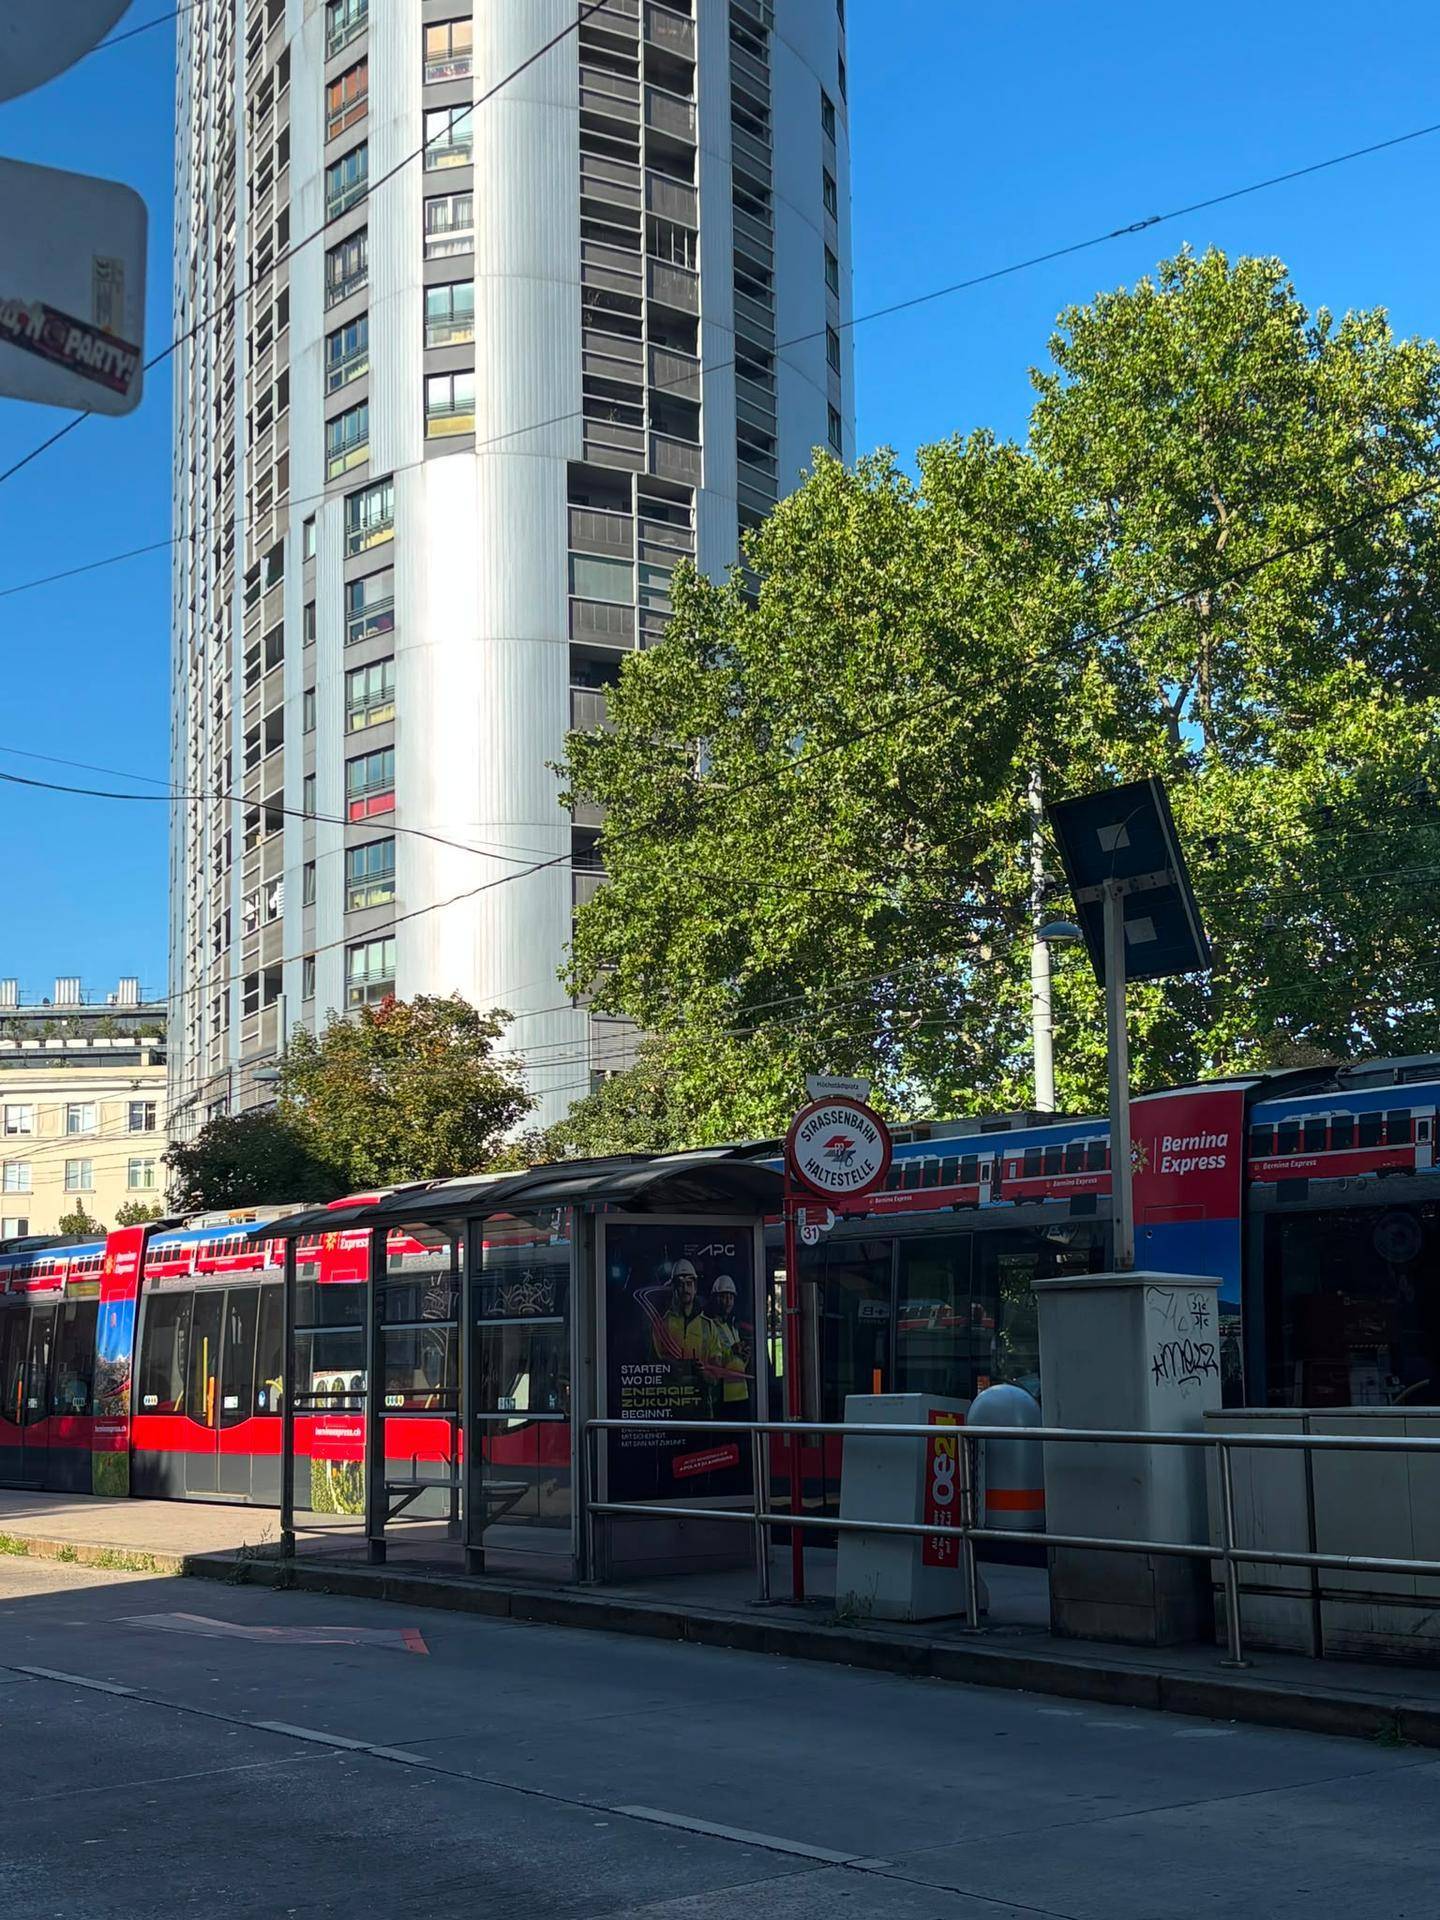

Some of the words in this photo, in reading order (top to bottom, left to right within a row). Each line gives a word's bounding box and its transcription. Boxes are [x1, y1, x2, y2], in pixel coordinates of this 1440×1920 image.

[64, 328, 137, 382] PARTY!
[801, 1110, 877, 1144] STRASSENBAHN
[1162, 1131, 1229, 1152] Bernina
[1161, 1152, 1227, 1176] Express
[1263, 1160, 1289, 1170] Bernina
[1290, 1158, 1318, 1169] Express
[804, 1157, 875, 1187] HALTESTELLE
[1075, 1177, 1098, 1187] Express
[803, 1226, 817, 1240] 31
[340, 1237, 369, 1251] Express
[621, 1364, 671, 1374] STARTEN
[621, 1376, 642, 1385] WO
[644, 1375, 662, 1385] DIE
[621, 1386, 700, 1396] ENERGIE-
[621, 1397, 702, 1407] ZUKUNFT
[621, 1408, 673, 1419] BEGINNT.
